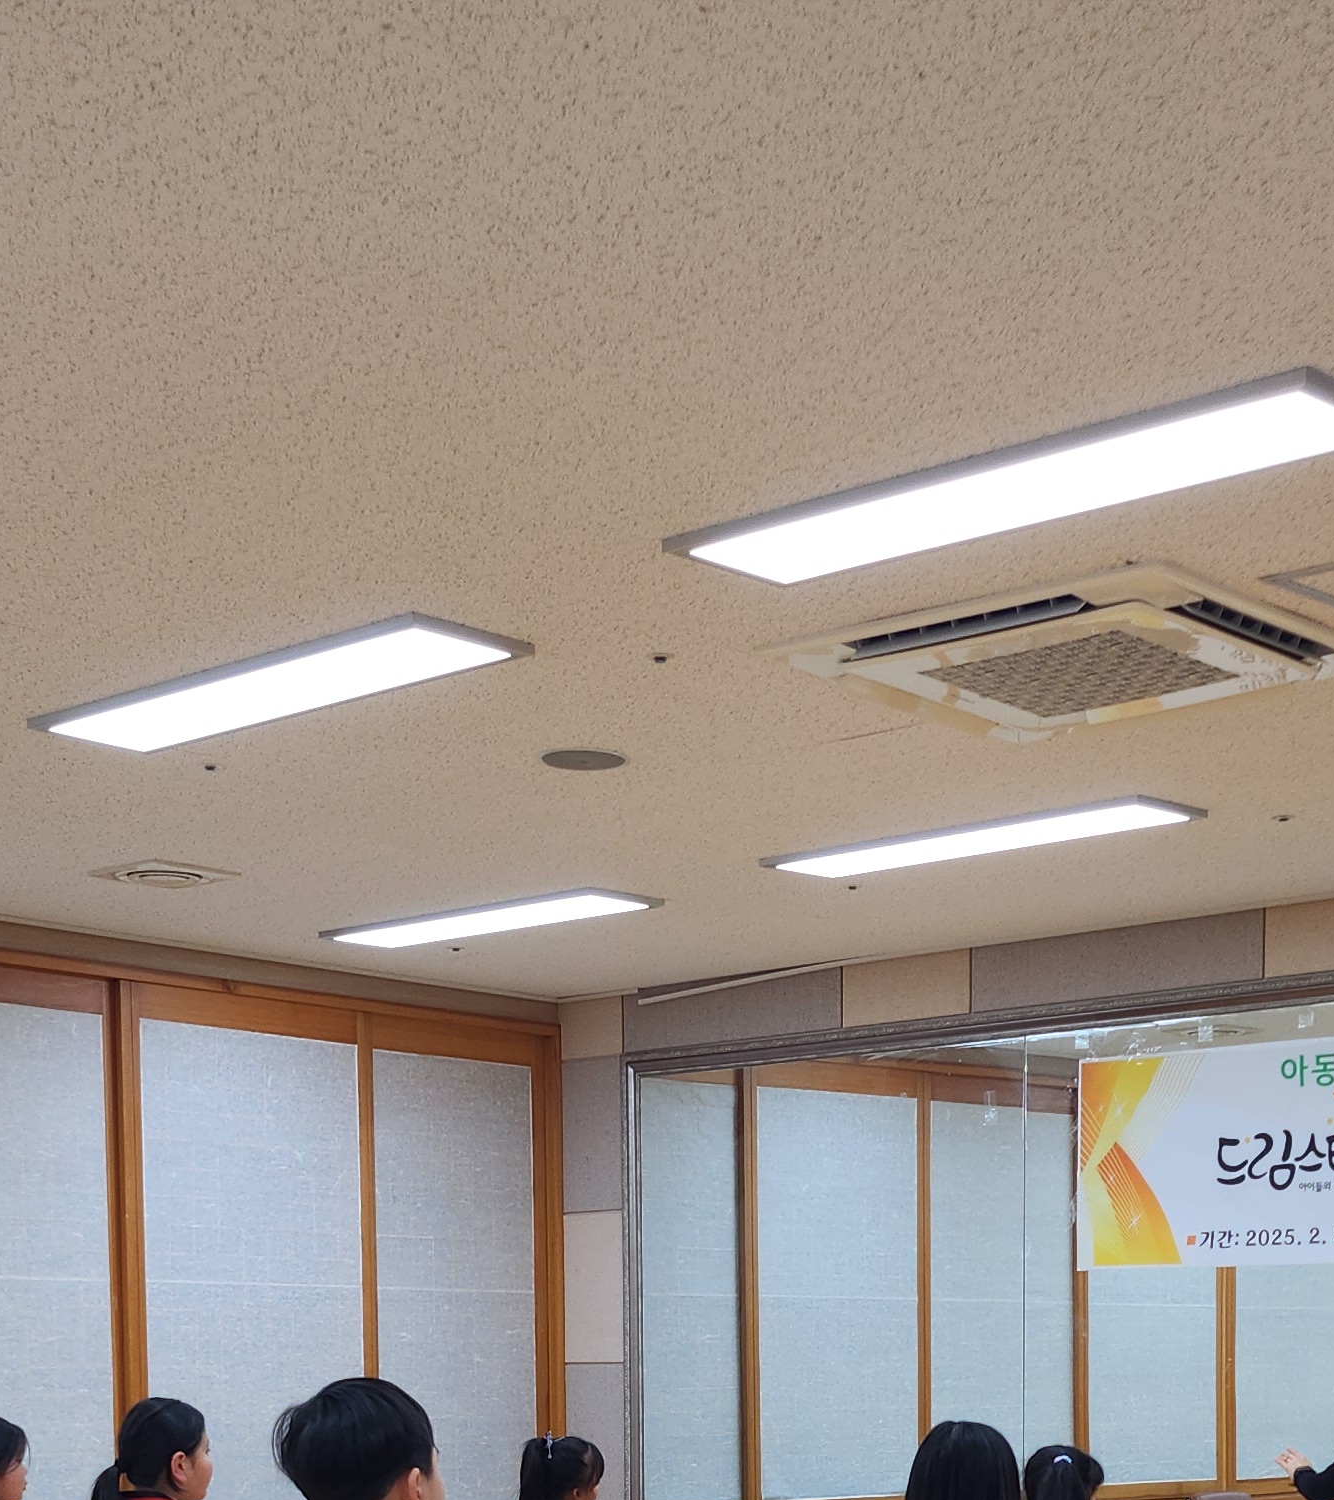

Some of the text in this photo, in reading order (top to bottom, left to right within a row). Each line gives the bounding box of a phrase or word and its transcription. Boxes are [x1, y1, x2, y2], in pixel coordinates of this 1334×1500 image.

[1199, 1230, 1240, 1249] 기간:
[1245, 1228, 1302, 1247] 2025.
[1308, 1227, 1327, 1245] 2.
